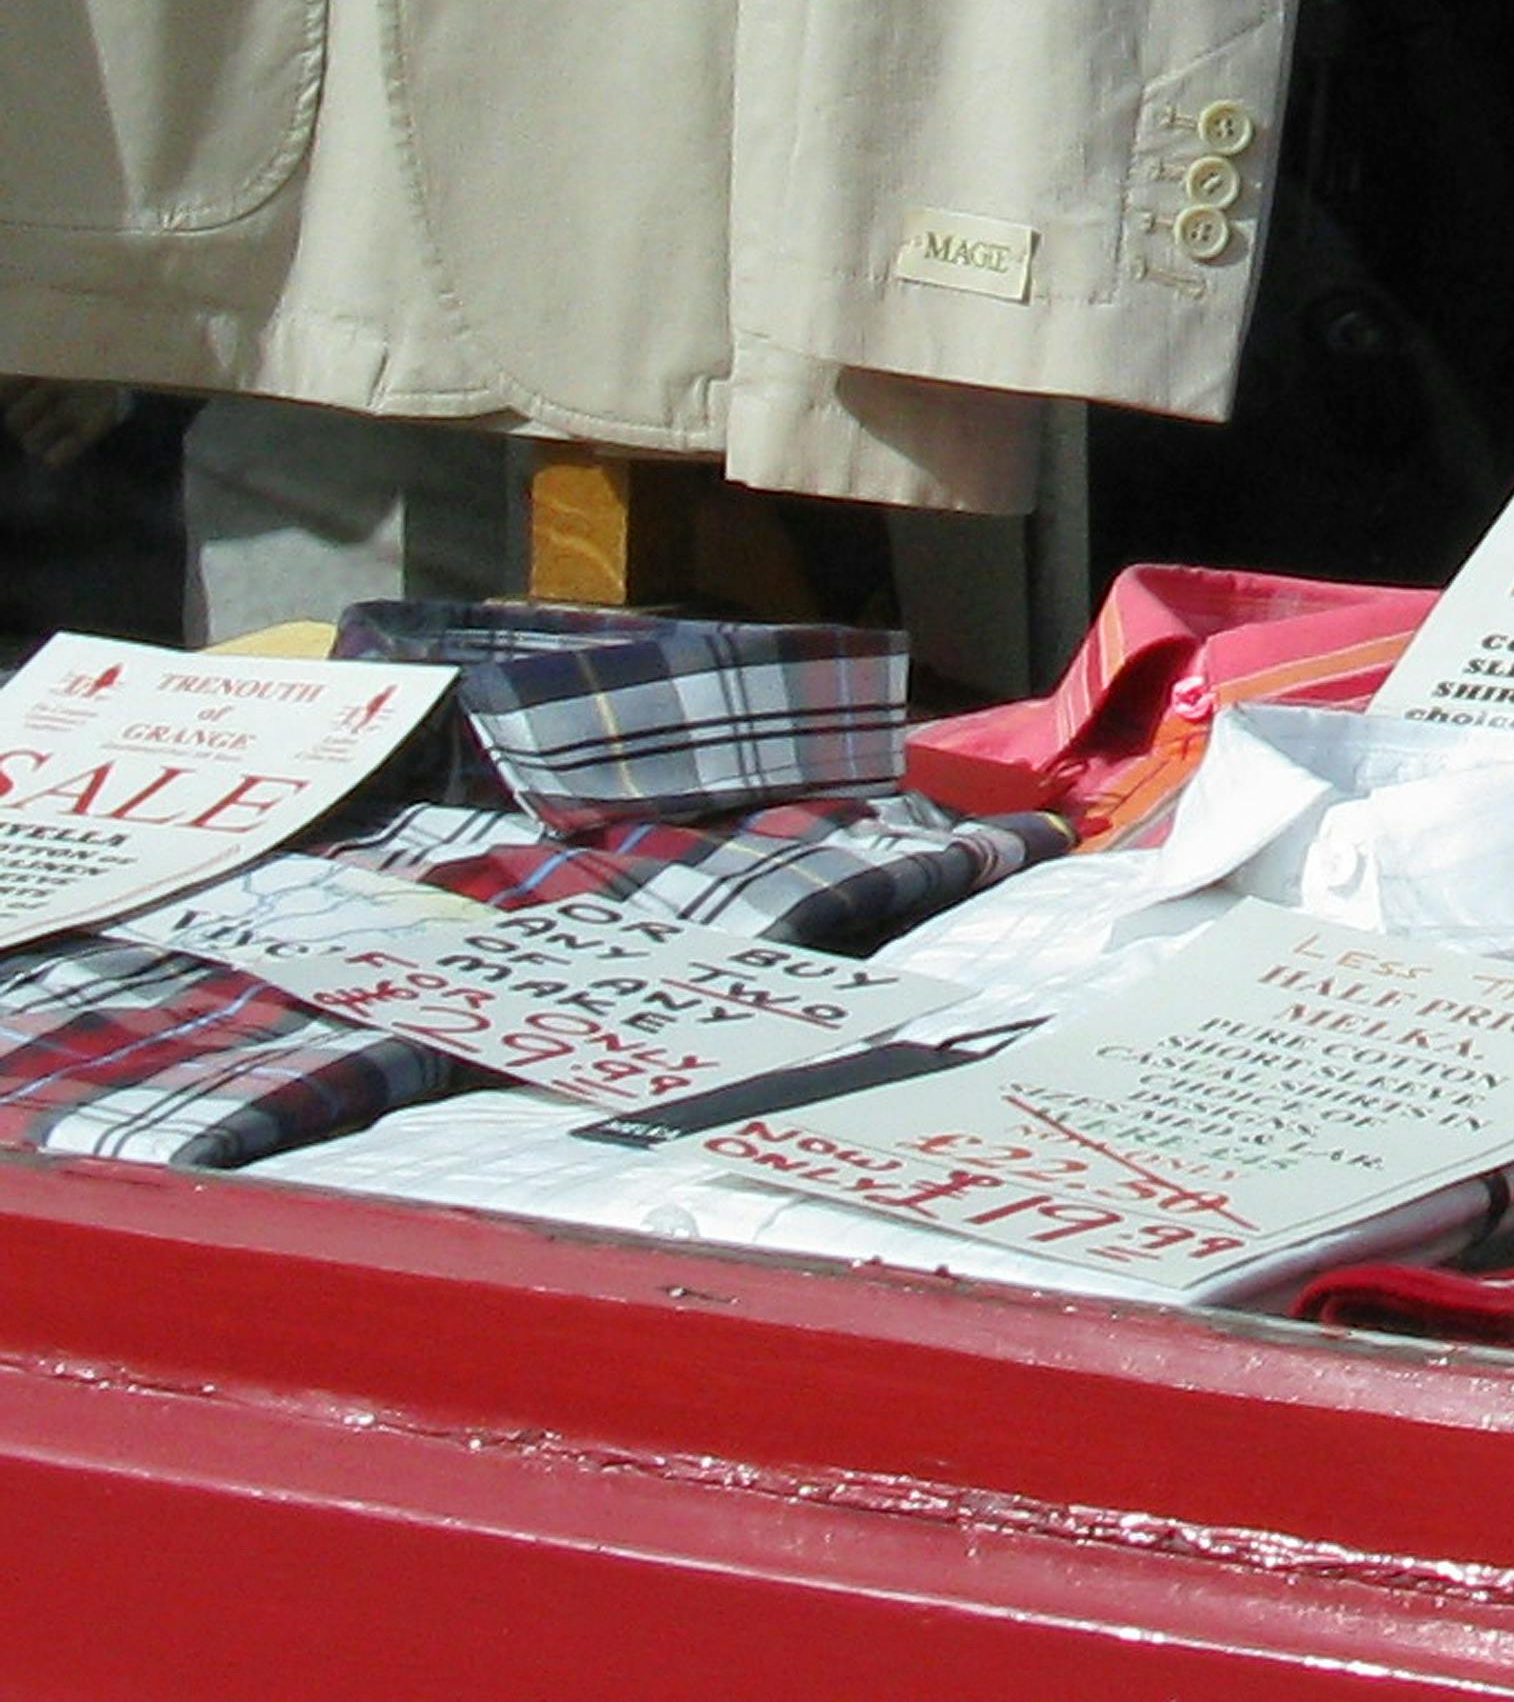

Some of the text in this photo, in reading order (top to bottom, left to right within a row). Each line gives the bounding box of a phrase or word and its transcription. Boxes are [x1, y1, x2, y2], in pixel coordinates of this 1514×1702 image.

[156, 671, 327, 702] TRENOUTH
[197, 704, 235, 722] of
[120, 722, 258, 750] GRANGE
[464, 934, 756, 1024] OF ANY
[496, 916, 851, 1022] ANY TWO
[558, 902, 899, 990] OR BUY
[1292, 932, 1434, 982] LESS
[345, 951, 720, 1072] FOR ONLY
[437, 953, 678, 1035] MAKE
[1257, 963, 1420, 1009] HALF
[1199, 1015, 1512, 1090] PURE COTTON
[1273, 1001, 1487, 1062] MELKA.
[1094, 1043, 1493, 1134] CASUAL SHIRTS IN
[1138, 1071, 1389, 1129] CHOICE OF
[1157, 1033, 1493, 1107] SHORT SLEEVE
[736, 1119, 907, 1173] NOW
